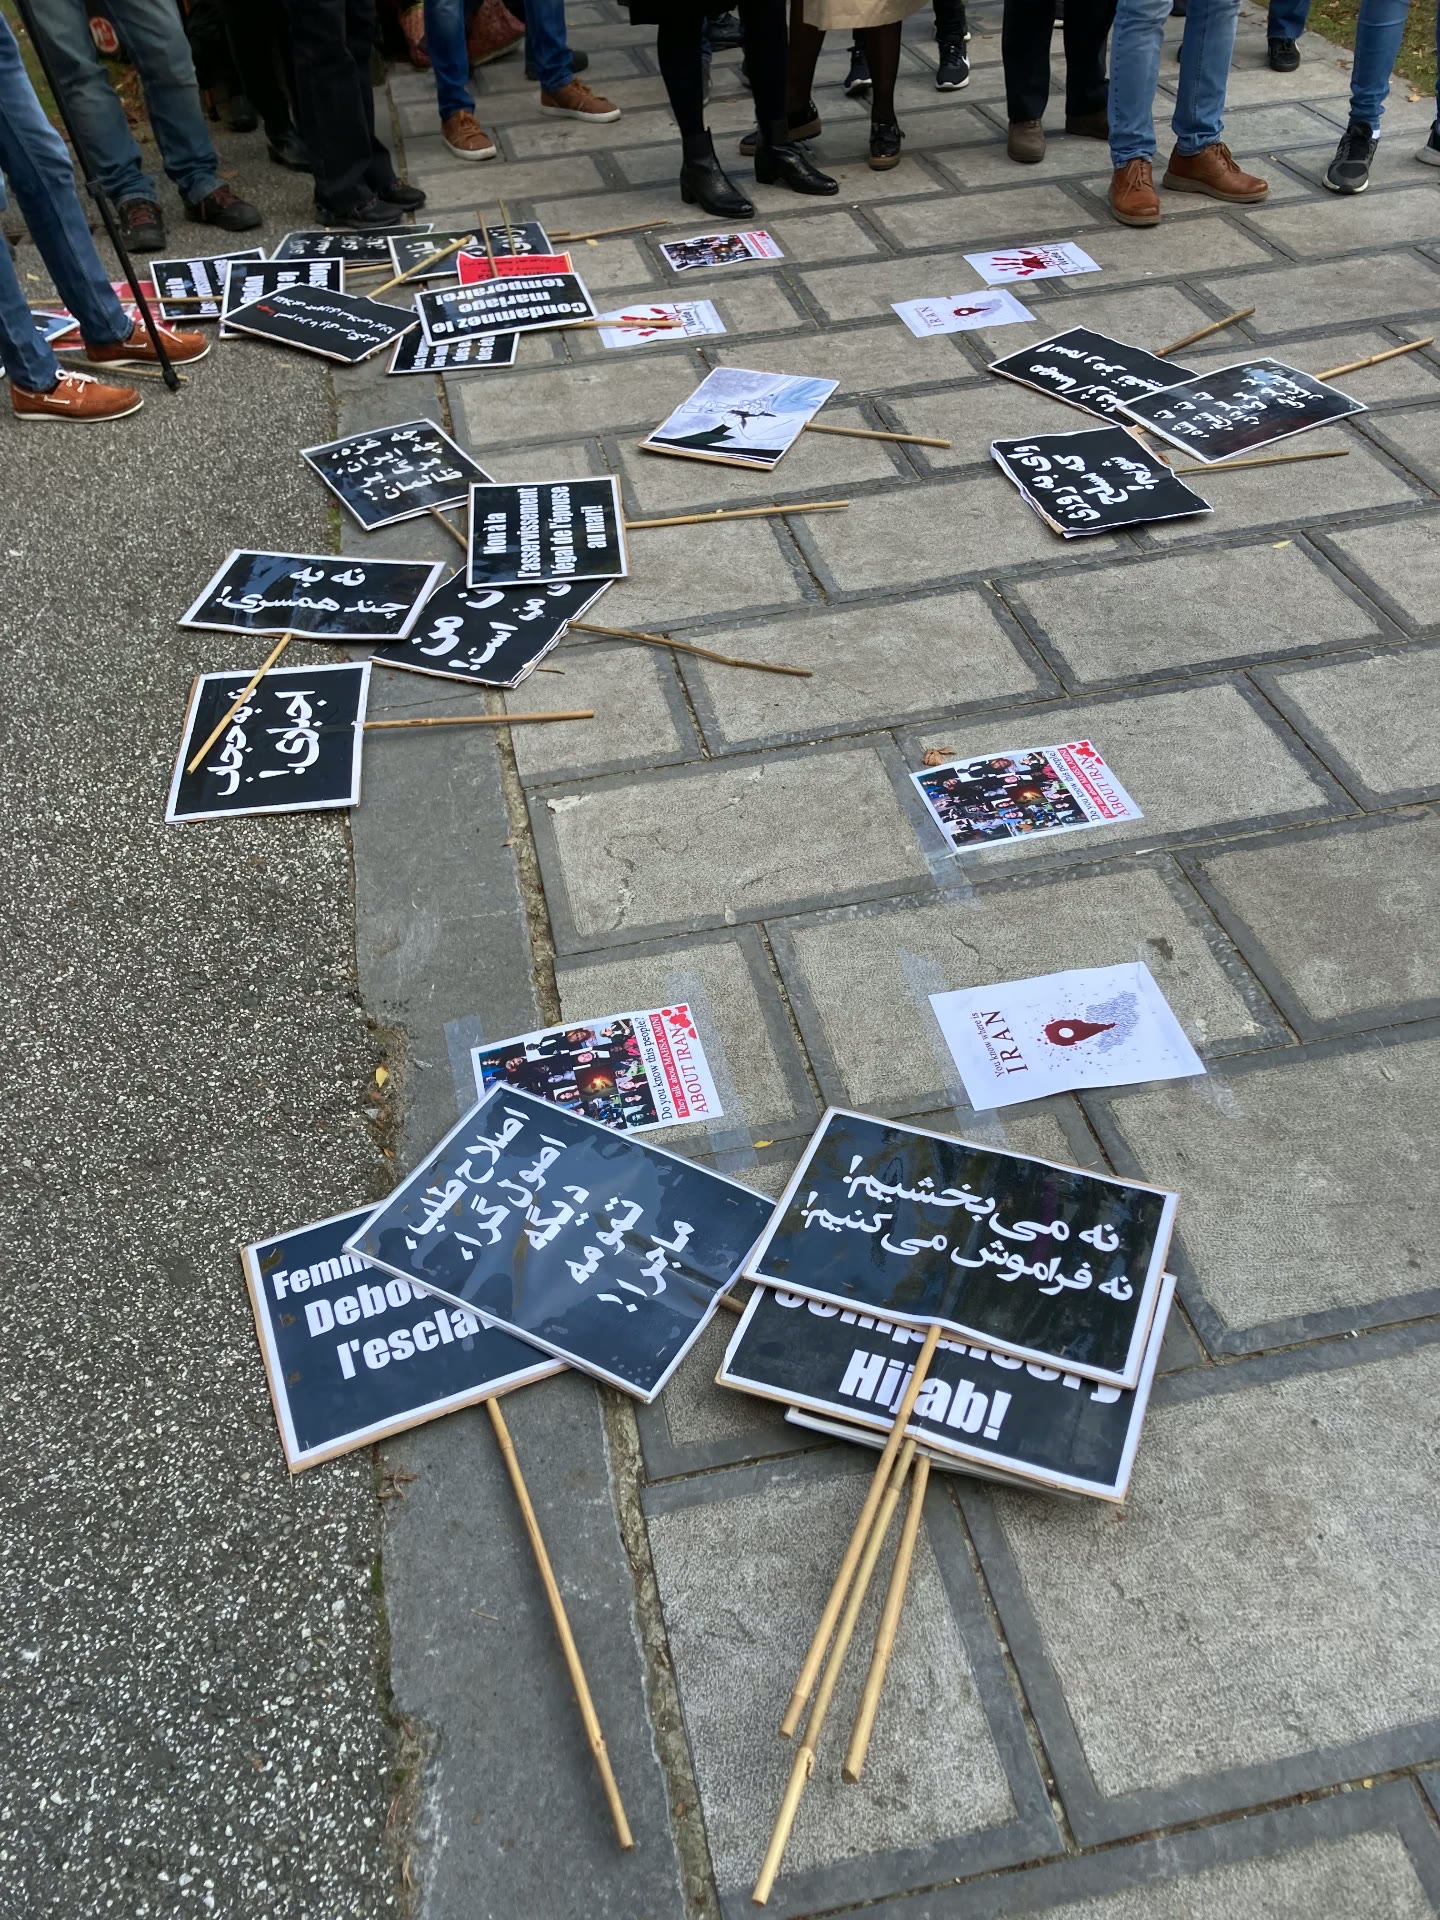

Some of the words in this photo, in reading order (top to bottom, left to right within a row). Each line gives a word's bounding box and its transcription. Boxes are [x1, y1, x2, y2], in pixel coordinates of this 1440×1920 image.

[309, 262, 331, 288] Nous
[240, 275, 264, 304] voyag
[435, 278, 565, 306] temporaire!
[458, 292, 550, 313] mariage
[432, 320, 454, 334] le
[457, 302, 588, 328] Condamnez
[1036, 344, 1088, 358] اسم
[1084, 356, 1128, 376] رمز
[391, 430, 421, 442] چه
[412, 442, 442, 454] چه
[392, 458, 442, 474] مرگ
[1052, 454, 1086, 472] که
[360, 472, 387, 488] بر
[1007, 445, 1052, 472] وای
[1031, 474, 1059, 489] به
[1052, 486, 1100, 522] روزی
[484, 512, 506, 524] la
[548, 486, 574, 529] l'épouse
[580, 505, 606, 532] mari!
[482, 524, 507, 532] à
[516, 487, 542, 578] l'asservissement
[550, 530, 574, 544] de
[482, 532, 507, 554] Non
[586, 534, 608, 548] au
[550, 546, 578, 574] légal
[290, 566, 324, 588] به
[330, 568, 366, 586] نه
[344, 599, 410, 619] چند
[1078, 757, 1104, 780] IRAN
[1096, 782, 1130, 816] ABOUT
[1090, 810, 1100, 821] Do
[651, 1016, 664, 1040] AMINI
[971, 1012, 980, 1020] is
[634, 1018, 654, 1046] people?
[975, 1020, 988, 1040] where
[659, 1042, 672, 1066] MAHSA
[670, 1028, 692, 1062] IRAN
[980, 1011, 1028, 1074] IRAN
[984, 1042, 998, 1061] know
[646, 1048, 656, 1062] this
[651, 1065, 664, 1088] know
[994, 1061, 1005, 1078] You
[658, 1089, 672, 1105] you
[681, 1065, 709, 1114] ABOUT
[662, 1106, 672, 1120] Do
[524, 1185, 590, 1250] دیگه
[565, 1196, 644, 1284] تمومه
[1079, 1222, 1120, 1252] نه
[272, 1254, 374, 1300] Femm
[596, 1220, 695, 1313] ماجرا!
[951, 1239, 1094, 1296] فراموش
[1098, 1276, 1134, 1300] نه
[336, 1308, 496, 1380] l'escla
[838, 1349, 1012, 1442] Hijab!
